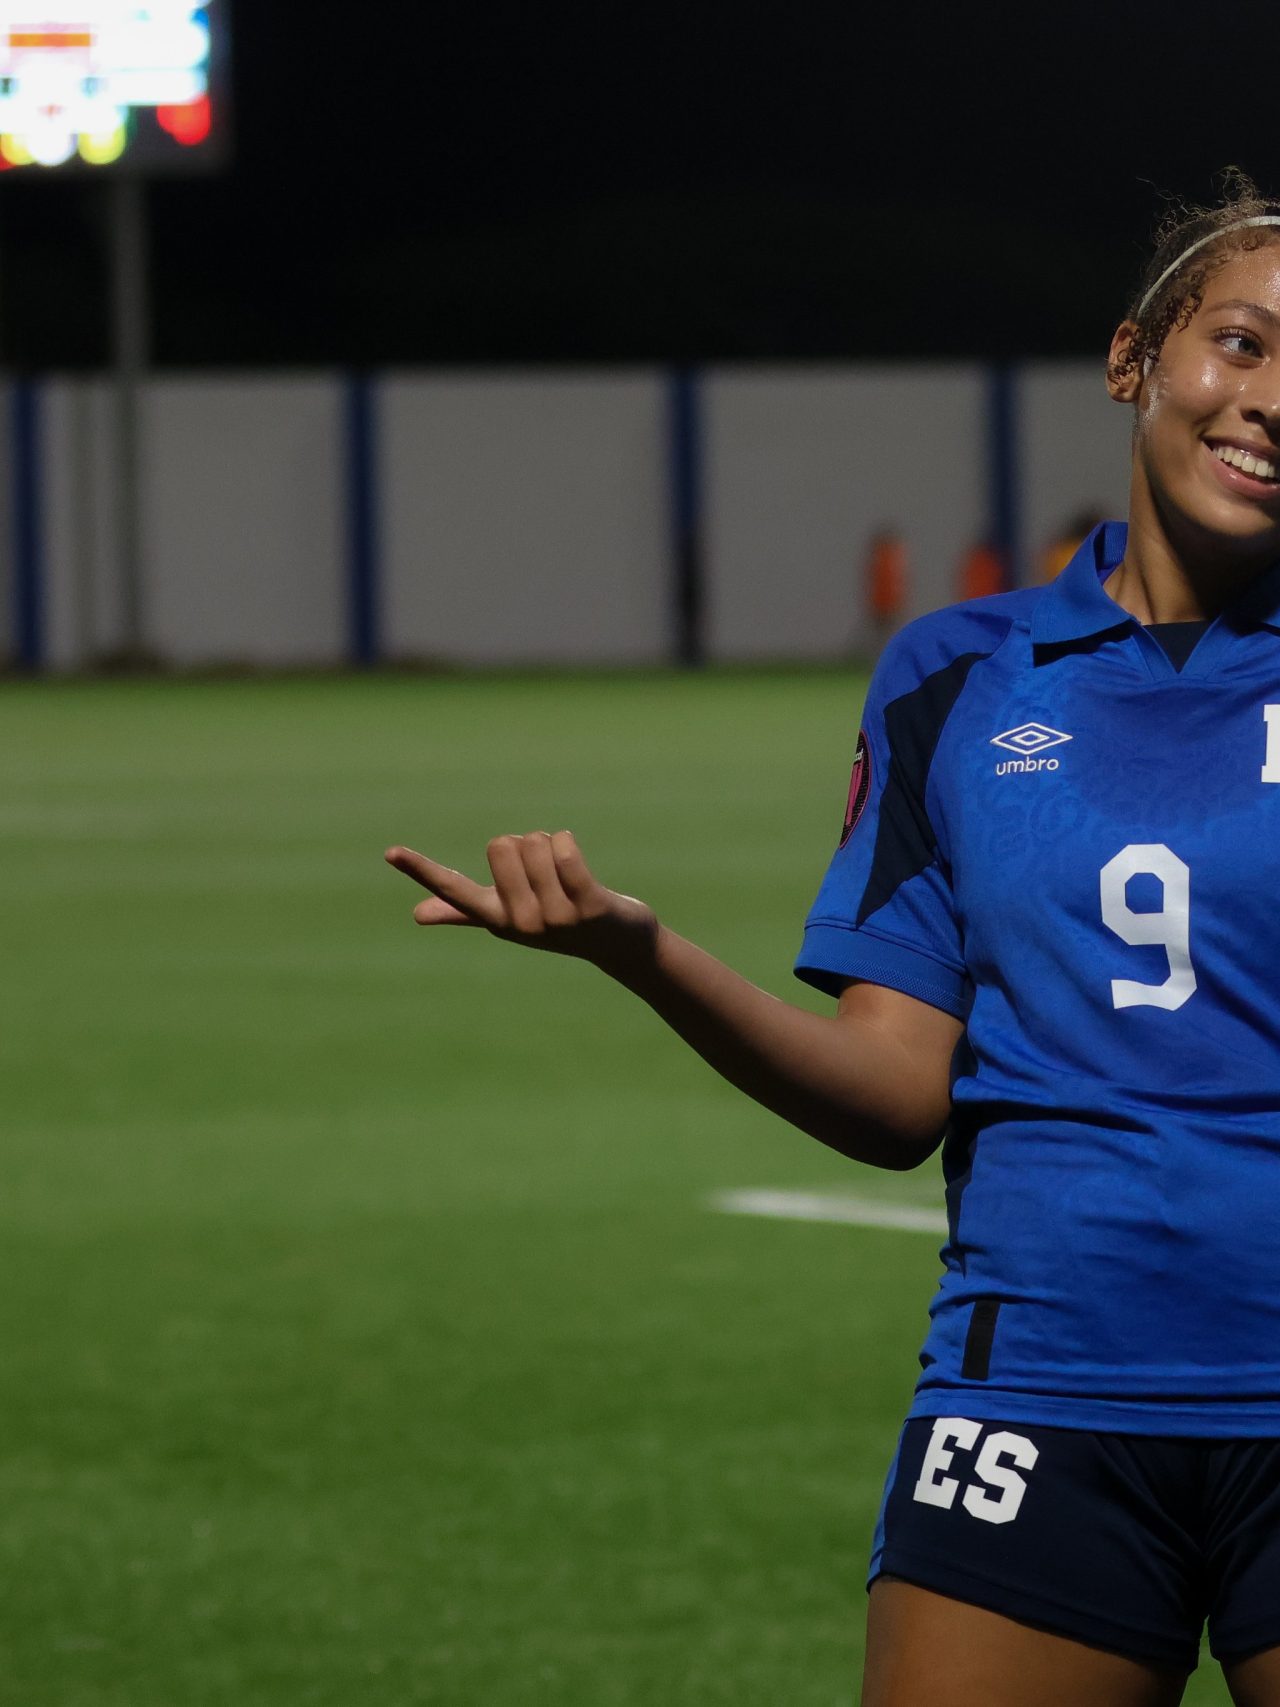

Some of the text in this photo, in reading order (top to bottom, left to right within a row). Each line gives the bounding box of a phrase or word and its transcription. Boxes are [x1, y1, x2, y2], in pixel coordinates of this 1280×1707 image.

[995, 755, 1060, 776] umbro
[1099, 843, 1197, 1012] 9
[912, 1416, 1040, 1525] ES
